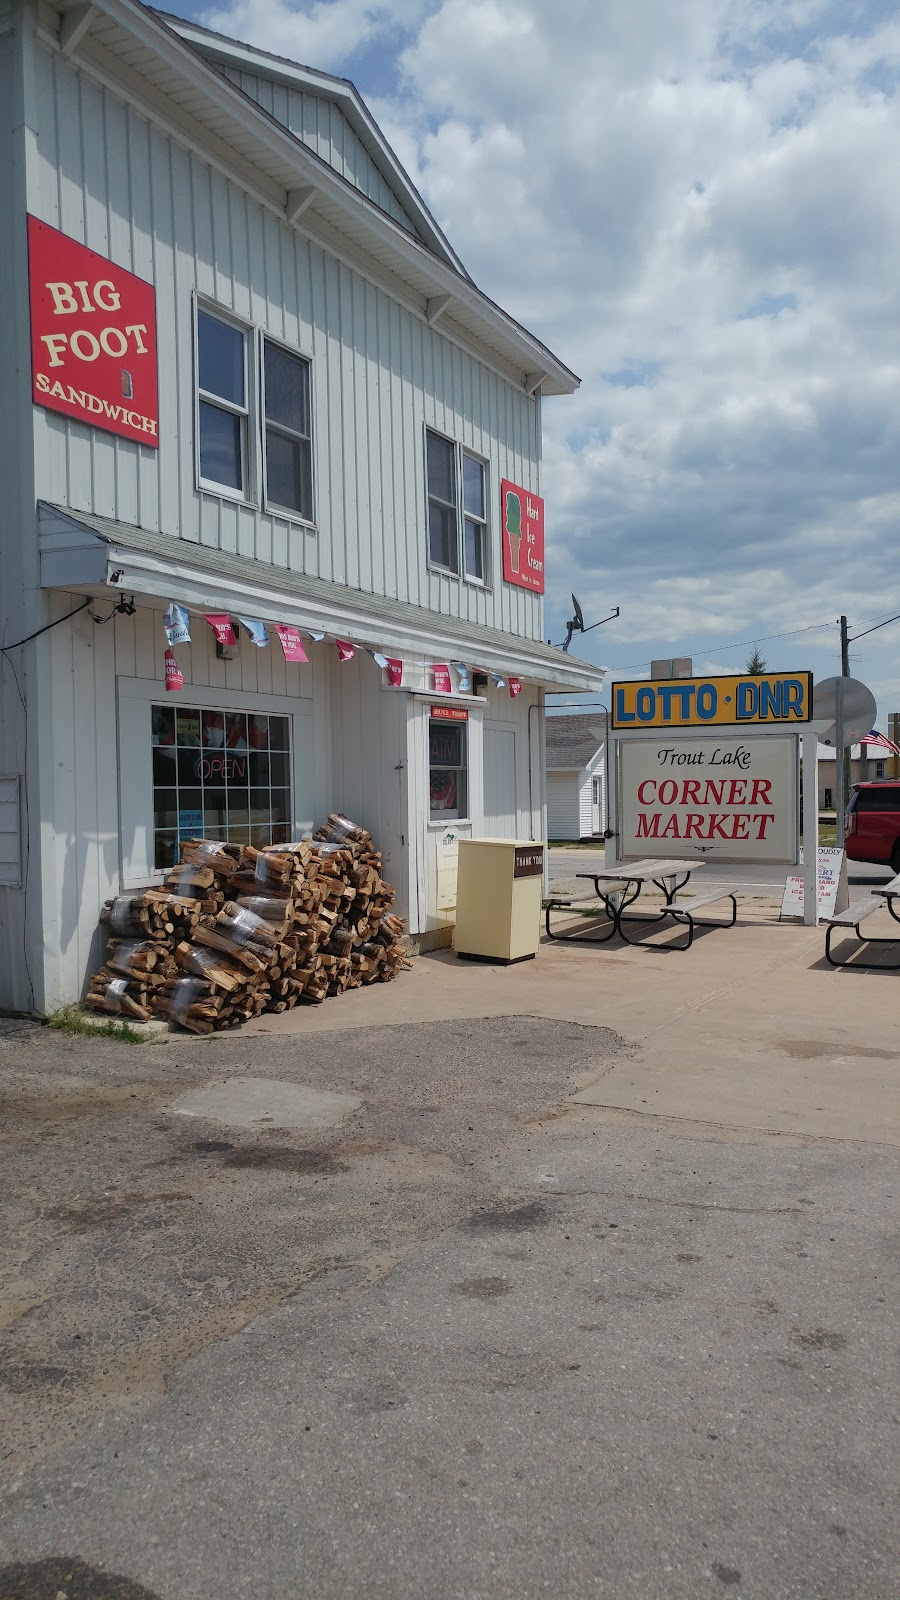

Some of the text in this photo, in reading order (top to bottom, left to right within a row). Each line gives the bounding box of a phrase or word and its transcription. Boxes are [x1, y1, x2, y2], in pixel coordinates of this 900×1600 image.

[46, 280, 121, 314] BIG
[41, 324, 149, 367] FOOT
[35, 373, 157, 436] SANDWICH
[526, 496, 539, 521] Hard
[526, 522, 535, 545] Ice
[527, 547, 543, 572] Cream
[616, 679, 803, 722] LOTTO DNR
[196, 759, 246, 779] OPEN
[657, 745, 752, 769] Trout Lake
[637, 779, 773, 805] CORNER
[635, 813, 775, 840] MARKET
[516, 855, 543, 866] THANK YOU
